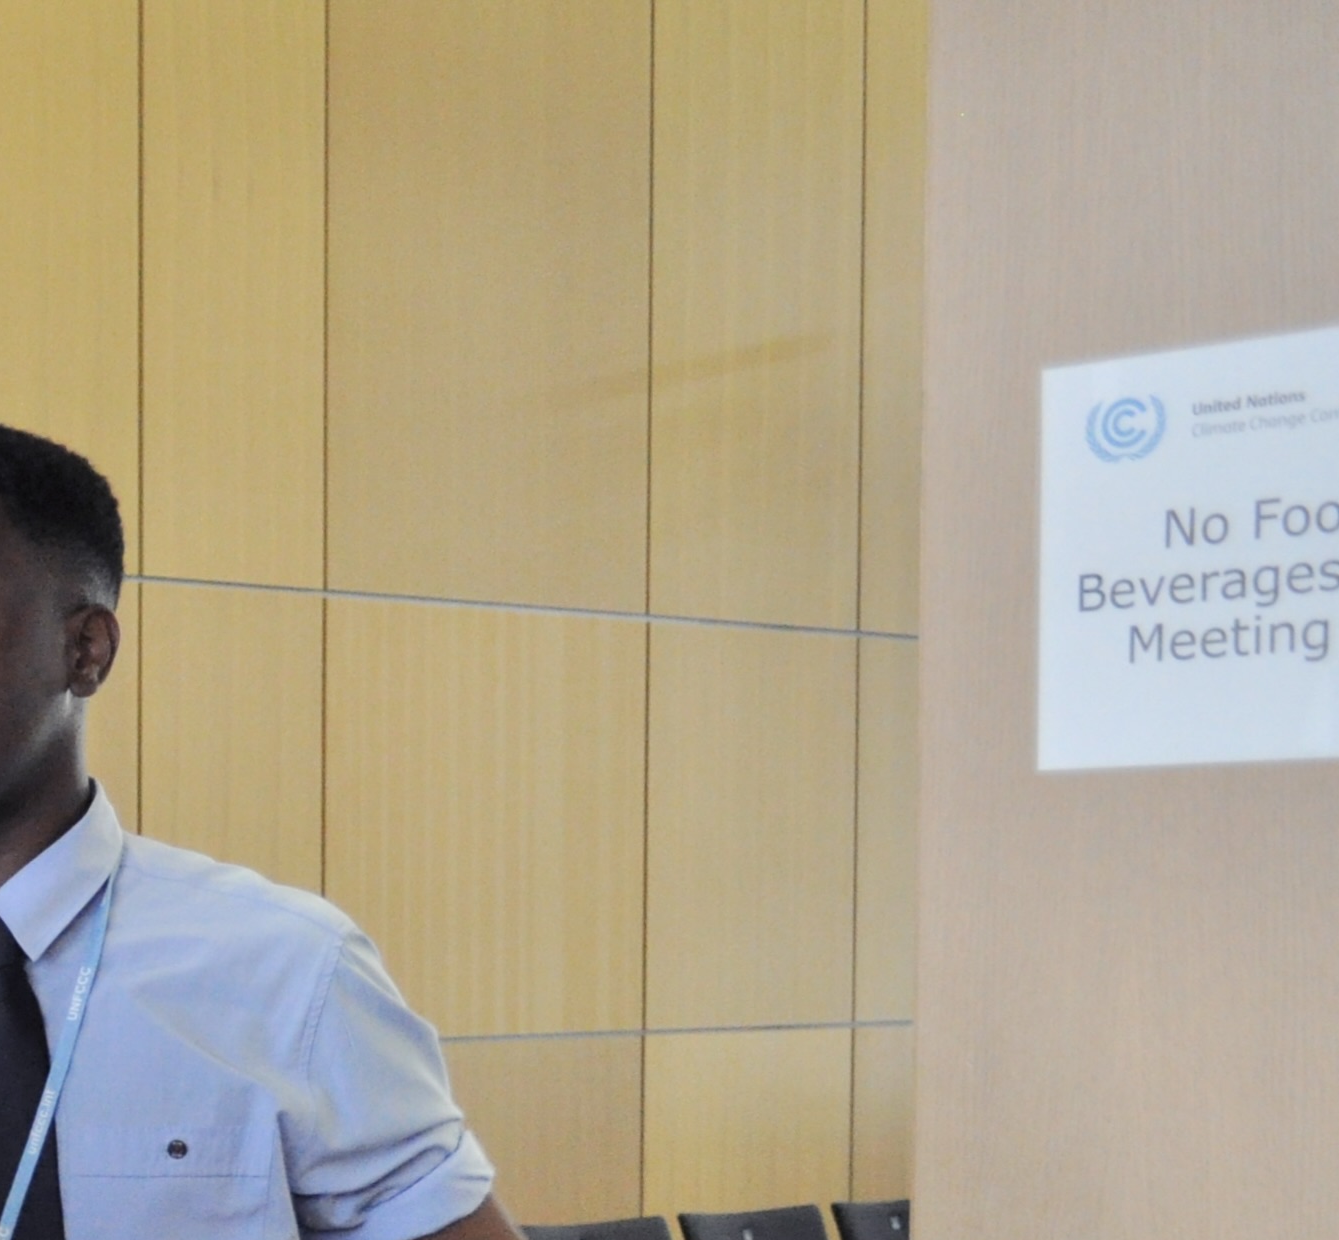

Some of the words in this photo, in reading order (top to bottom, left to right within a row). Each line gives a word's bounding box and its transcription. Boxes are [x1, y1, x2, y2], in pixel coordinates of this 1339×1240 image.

[1191, 396, 1241, 416] United
[1246, 390, 1307, 409] Nations
[1191, 420, 1246, 438] Climate
[1249, 413, 1307, 431] Change
[1164, 507, 1229, 549] No
[1254, 498, 1339, 539] Foo
[1078, 559, 1339, 613] Beverages
[1128, 615, 1330, 664] Meeting
[66, 966, 91, 1020] UNFCCC
[28, 1089, 56, 1155] unfccc.int
